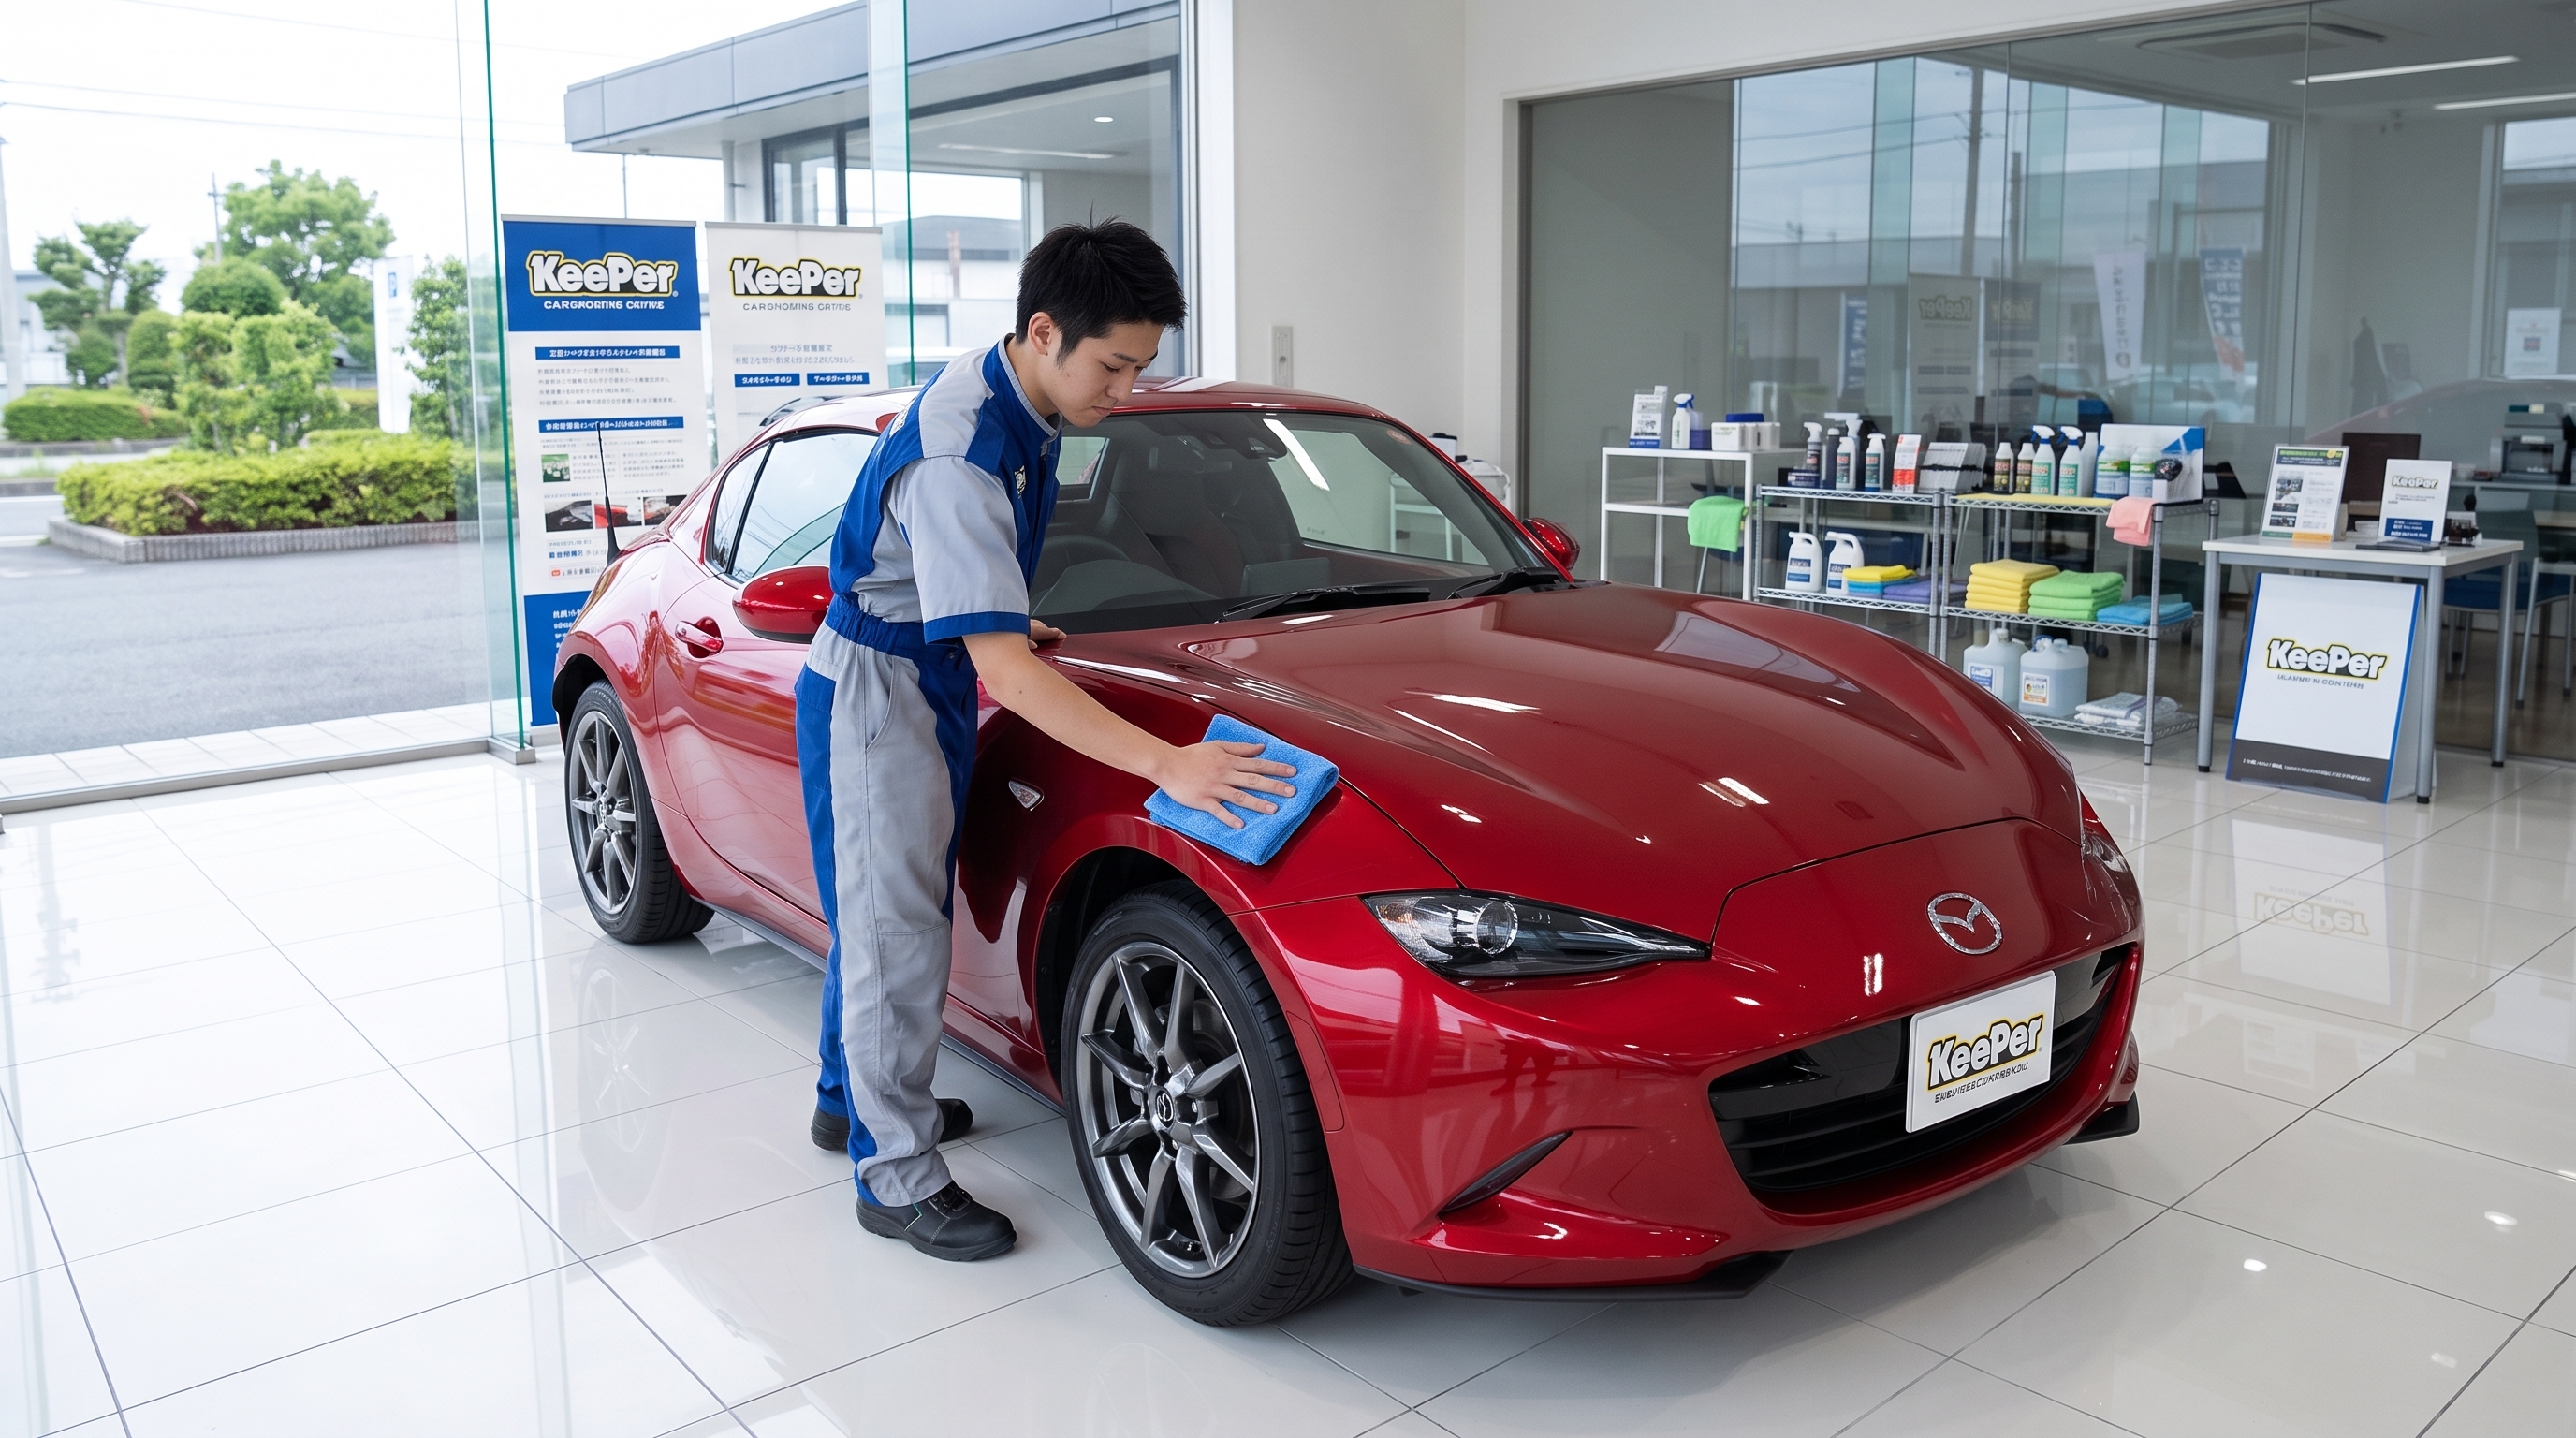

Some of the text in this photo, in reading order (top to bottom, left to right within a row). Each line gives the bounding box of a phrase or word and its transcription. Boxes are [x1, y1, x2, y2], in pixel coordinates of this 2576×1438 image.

[528, 252, 676, 294] KeePer
[730, 257, 861, 297] KeePer
[2267, 638, 2388, 680] KeePer
[1928, 1014, 2044, 1091] KeePer
